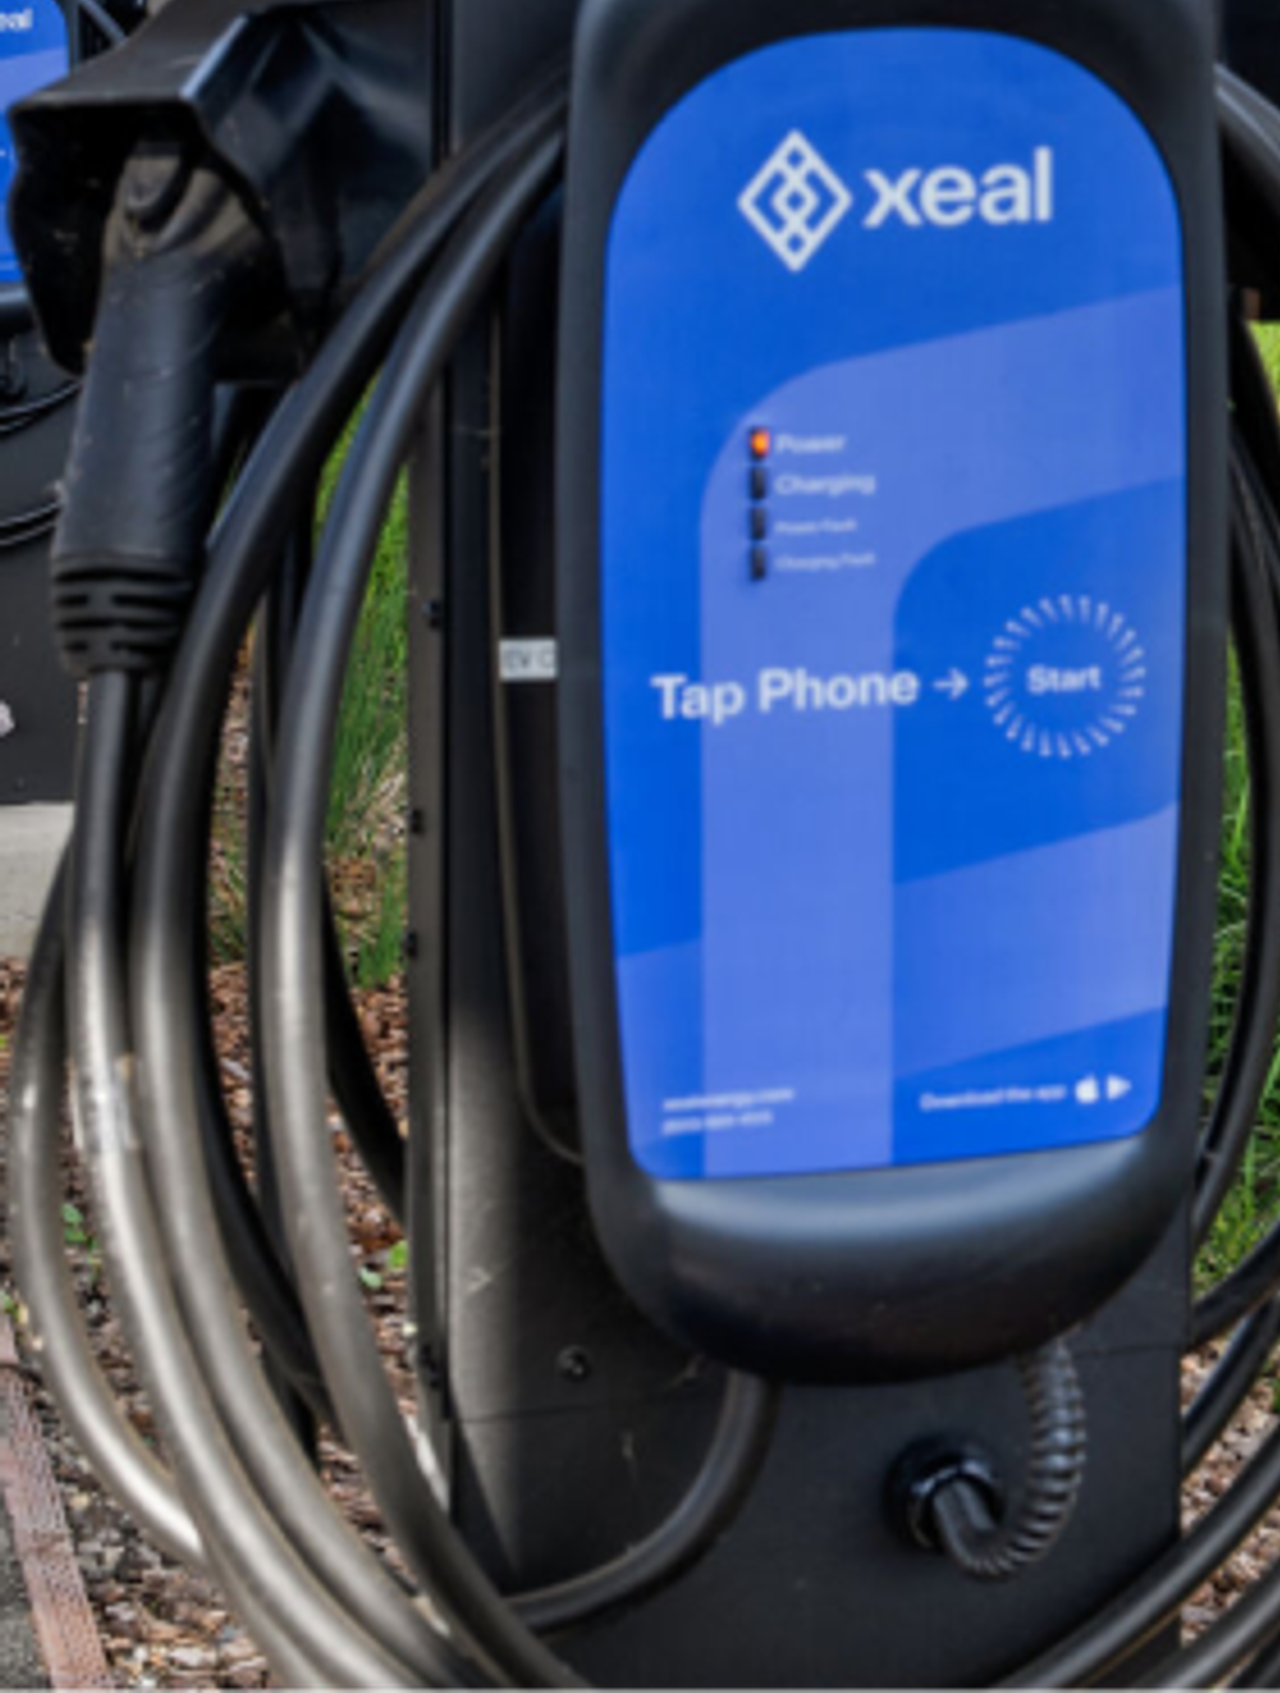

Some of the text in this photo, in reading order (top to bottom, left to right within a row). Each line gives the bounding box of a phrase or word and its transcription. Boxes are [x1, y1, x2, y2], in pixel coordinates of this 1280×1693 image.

[862, 146, 1054, 229] xeal
[774, 432, 847, 455] Power
[774, 473, 876, 498] Charging
[650, 664, 1101, 726] Tap Phone Start
